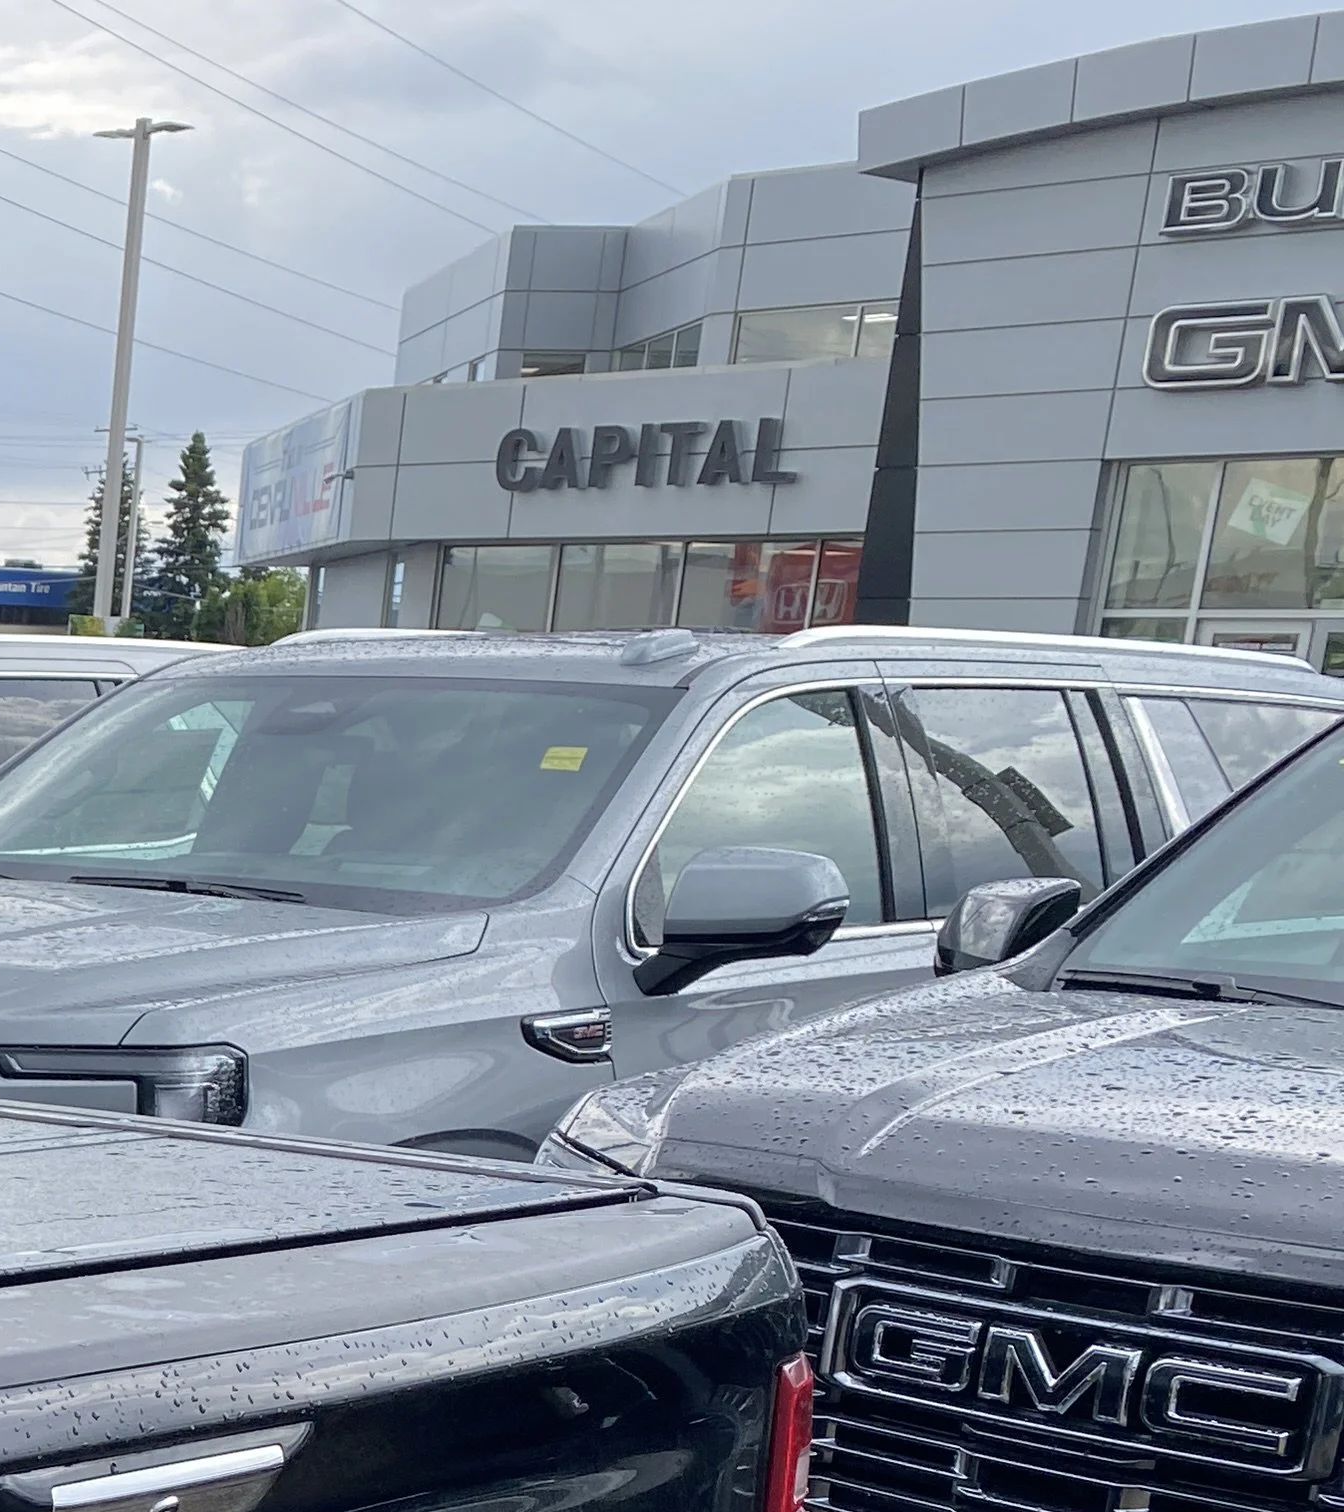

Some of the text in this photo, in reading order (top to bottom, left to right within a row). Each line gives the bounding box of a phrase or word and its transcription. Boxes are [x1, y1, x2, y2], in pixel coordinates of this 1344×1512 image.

[496, 417, 799, 491] CAPITAL
[30, 581, 50, 594] Tire
[852, 1304, 1304, 1458] GMC
